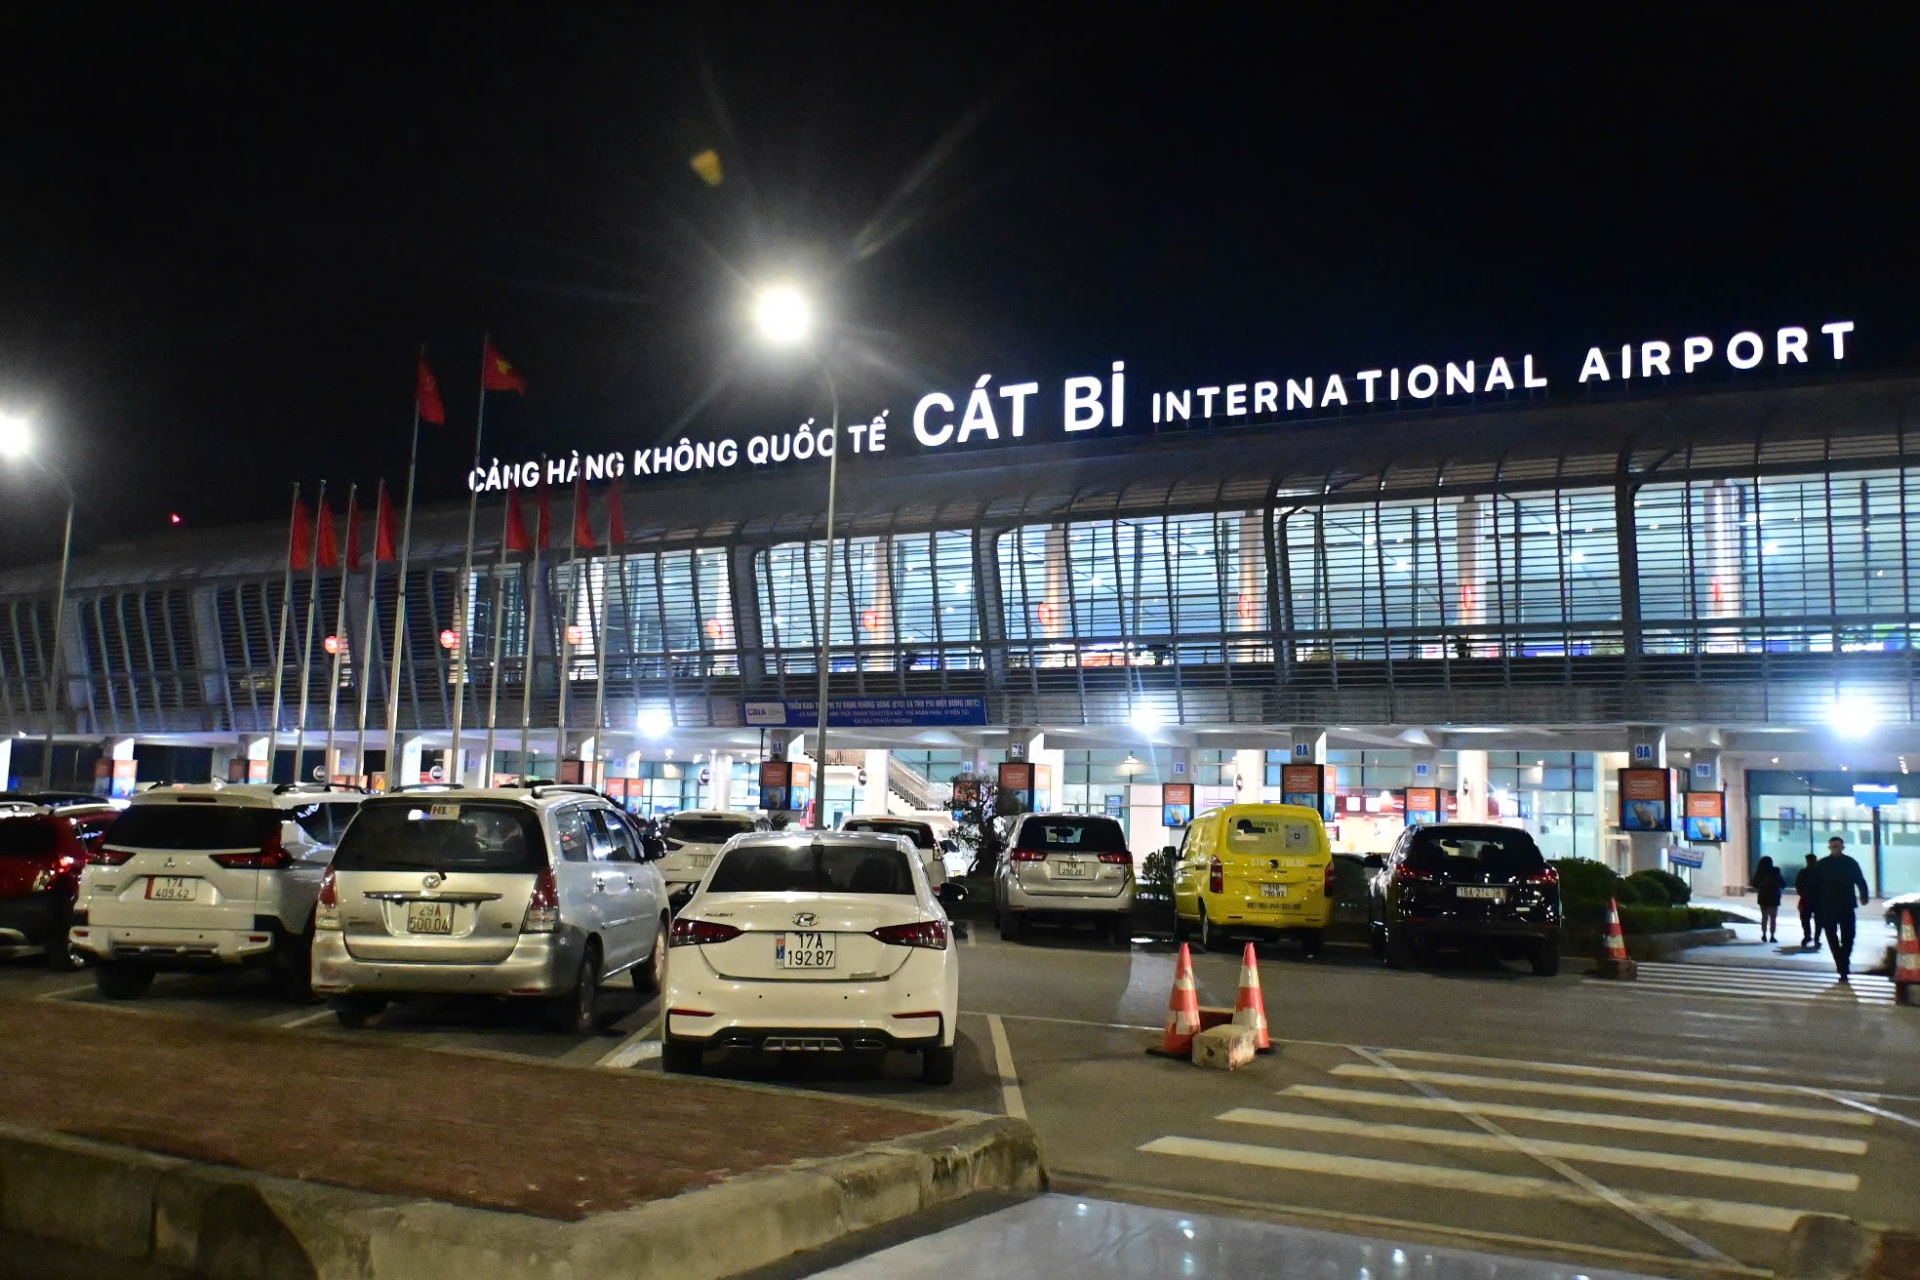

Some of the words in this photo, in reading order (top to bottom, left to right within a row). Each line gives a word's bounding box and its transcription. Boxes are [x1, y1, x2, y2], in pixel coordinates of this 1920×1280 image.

[1152, 354, 1548, 424] INTERNATIONAL
[1578, 320, 1855, 384] AIRPORT
[912, 373, 1039, 447] CÁT
[468, 457, 541, 493] CẢNG
[547, 449, 625, 485] HÀNG
[634, 437, 738, 476] KHÔNG
[747, 417, 834, 465] QUỐC
[848, 409, 889, 454] TẾ
[1296, 745, 1309, 757] 8A
[1636, 745, 1651, 759] 9A
[1174, 763, 1185, 773] 7B
[1697, 765, 1710, 776] 9B
[419, 904, 442, 917] 29A
[409, 916, 449, 932] 500.04
[799, 933, 823, 949] 17A
[787, 950, 834, 966] 192.87
